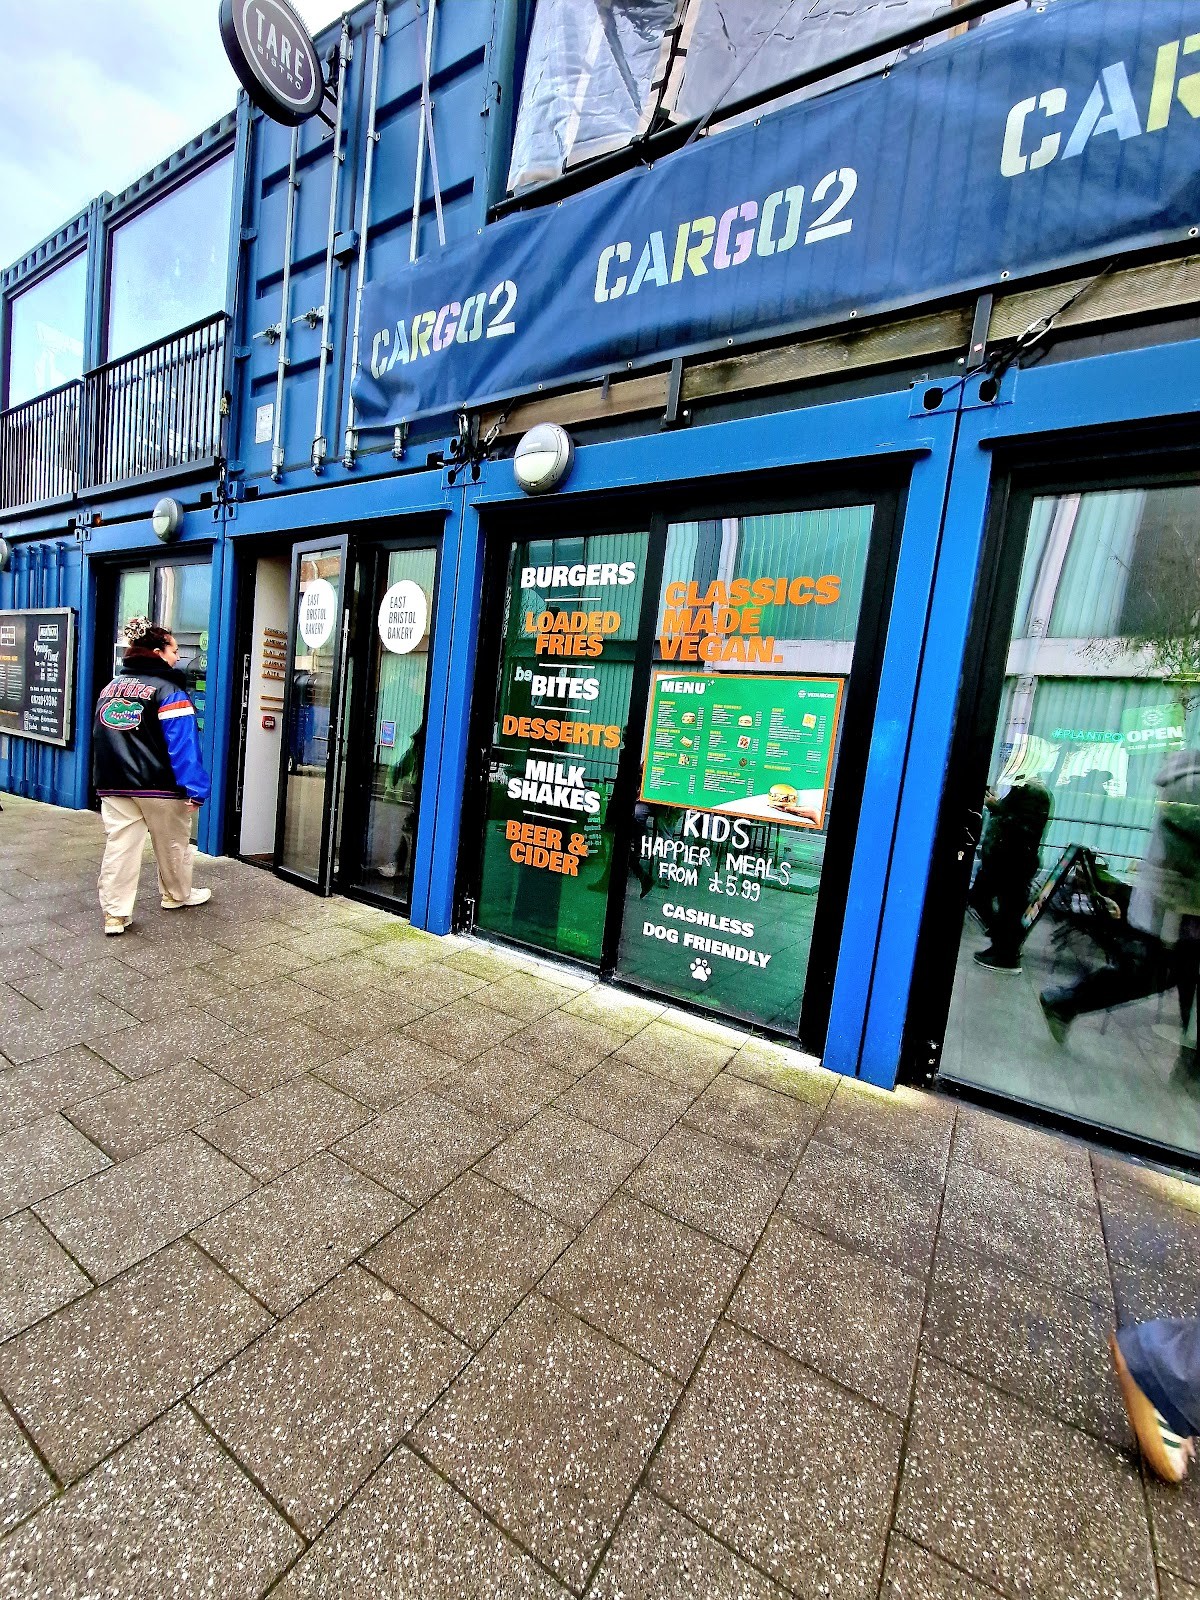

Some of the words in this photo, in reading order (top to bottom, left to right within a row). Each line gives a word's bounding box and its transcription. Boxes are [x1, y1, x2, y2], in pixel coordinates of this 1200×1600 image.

[256, 8, 304, 81] TARE
[257, 44, 301, 90] BISTRO
[594, 167, 858, 303] CARGO2
[370, 280, 518, 380] CARGO2
[520, 562, 636, 588] BURGERS
[307, 594, 320, 606] EAST
[389, 596, 407, 608] EAST
[665, 575, 841, 607] CLASSICS
[306, 608, 327, 620] BRISTOL
[388, 612, 417, 623] BRISTOL
[524, 611, 621, 633] LOADED
[662, 608, 762, 634] MADE
[305, 623, 325, 635] BAKERY
[387, 627, 414, 639] BAKERY
[535, 633, 603, 657] FRIES
[659, 635, 784, 663] VEGAN.
[531, 675, 600, 701] BITES
[660, 680, 706, 695] MENU
[502, 715, 621, 748] DESSERTS
[1051, 728, 1126, 742] #PLANTPO
[1126, 726, 1183, 743] OPEN
[525, 759, 586, 789] MILK
[507, 778, 601, 814] SHAKES
[505, 820, 562, 850] BEER
[567, 833, 588, 857] &
[683, 809, 751, 849] KIDS
[509, 842, 580, 877] CIDER
[640, 835, 711, 867] HAPPIER
[725, 852, 792, 886] MEALS
[658, 862, 698, 887] FROM
[708, 871, 761, 902] £5.99
[662, 903, 755, 938] CASHLESS
[642, 921, 679, 944] DOG
[683, 932, 772, 969] FRIENDLY
